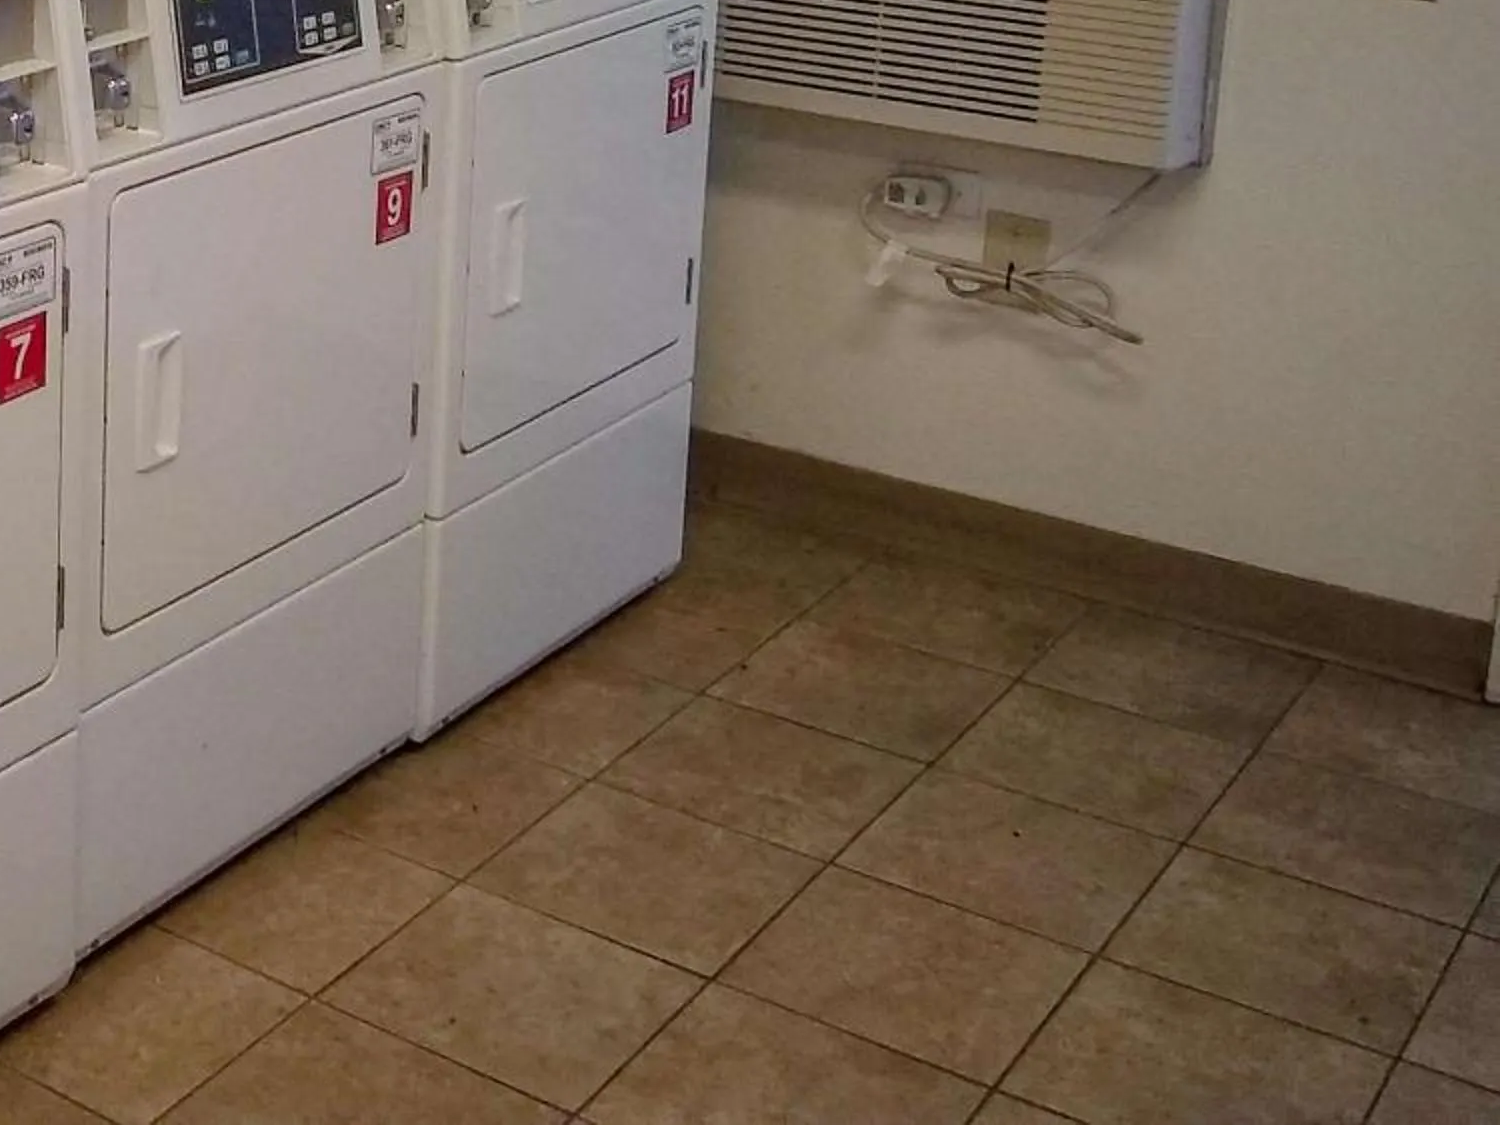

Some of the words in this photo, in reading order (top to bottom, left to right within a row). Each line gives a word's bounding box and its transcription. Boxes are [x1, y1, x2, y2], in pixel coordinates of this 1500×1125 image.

[671, 82, 689, 118] 11
[387, 187, 402, 226] 9
[10, 332, 32, 380] 7
